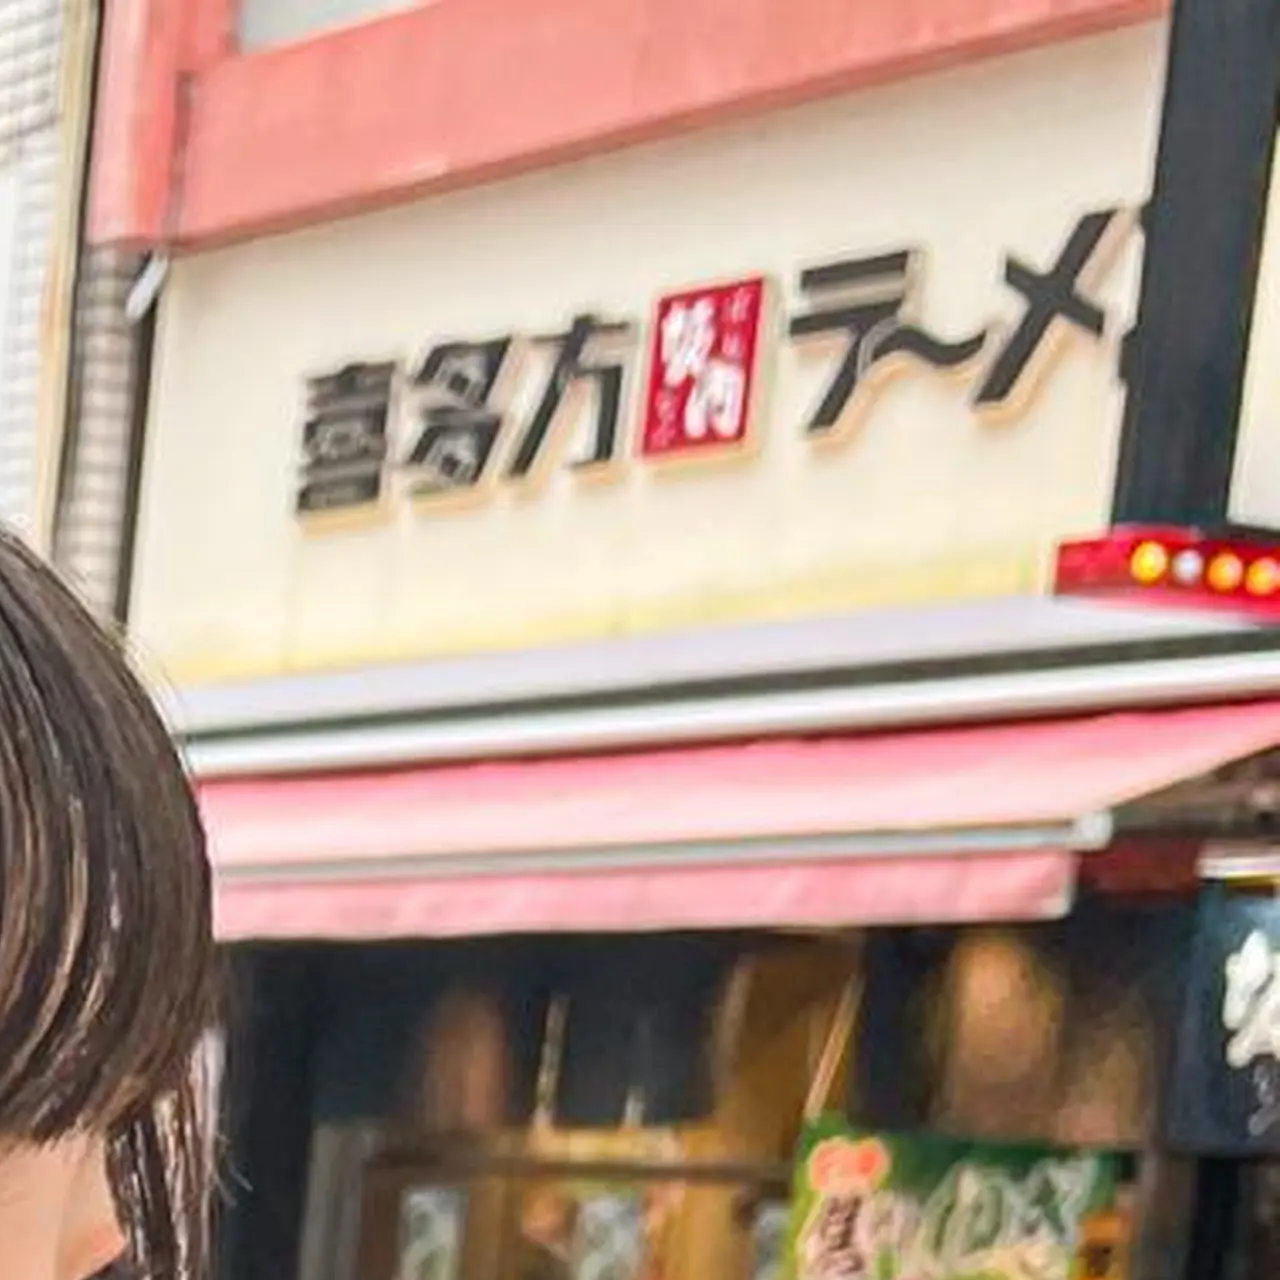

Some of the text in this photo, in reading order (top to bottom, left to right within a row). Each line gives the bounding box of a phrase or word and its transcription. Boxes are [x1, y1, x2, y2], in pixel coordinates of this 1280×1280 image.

[297, 314, 630, 511] 喜多方
[788, 200, 1150, 434] ラーメ
